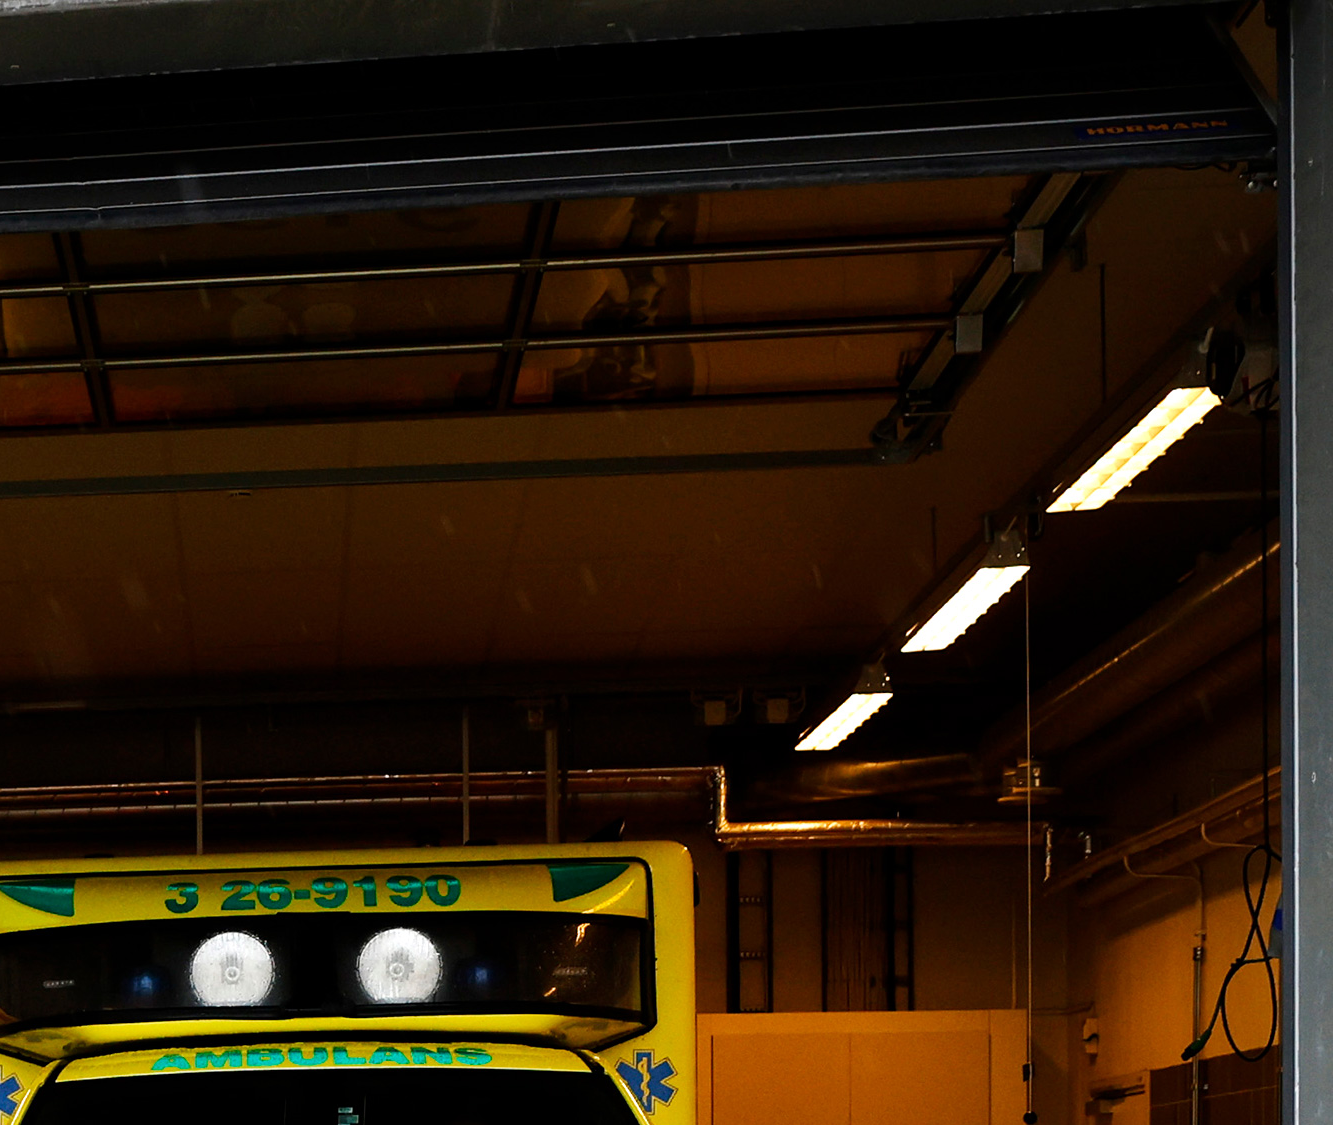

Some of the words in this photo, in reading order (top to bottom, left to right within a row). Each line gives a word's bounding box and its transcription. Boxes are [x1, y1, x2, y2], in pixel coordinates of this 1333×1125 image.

[164, 881, 200, 914] 3
[220, 874, 462, 911] 26-9190
[150, 1045, 493, 1071] AMBULANS
